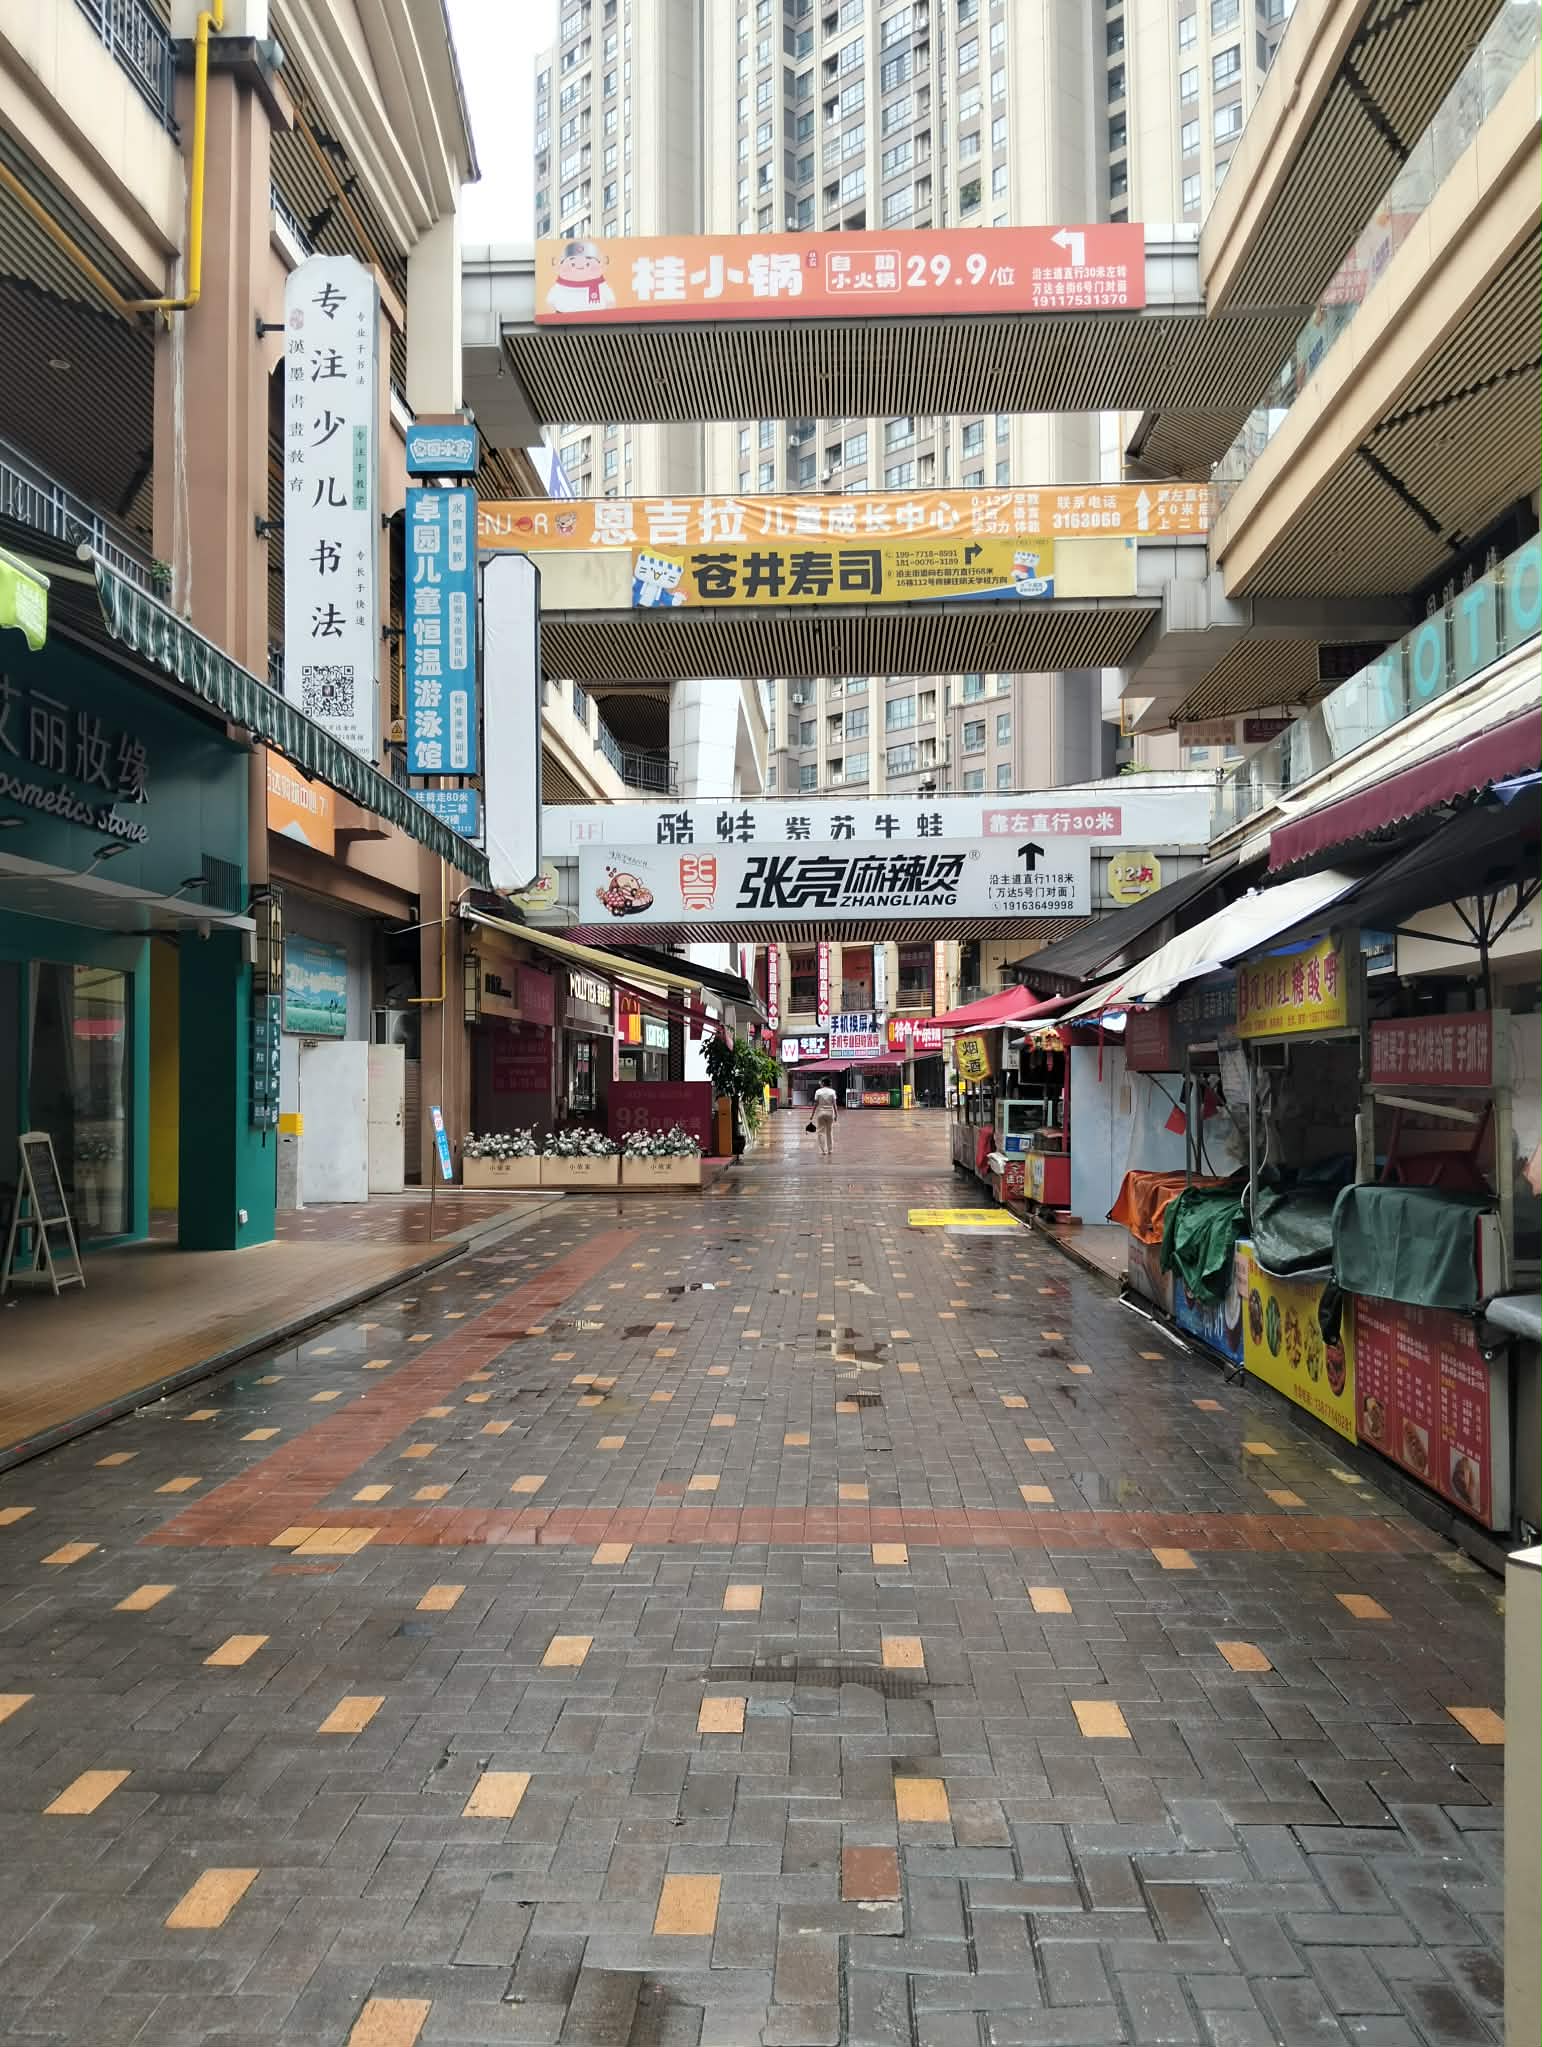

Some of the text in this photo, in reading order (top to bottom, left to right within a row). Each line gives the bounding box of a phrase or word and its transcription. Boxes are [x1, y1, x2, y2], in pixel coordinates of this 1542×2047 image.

[831, 255, 897, 272] 自助
[632, 253, 804, 300] 桂小锅
[831, 272, 897, 289] 小火锅
[1031, 294, 1128, 307] 19117531370
[310, 281, 349, 640] 专注少儿书法
[1056, 494, 1118, 511] 联系电话
[591, 501, 748, 545] 恩吉拉
[691, 550, 882, 600] 苍井寿司
[785, 812, 944, 840] 紫苏牛蛙
[989, 811, 1115, 833] 靠左直行30米
[736, 852, 967, 909] 张亮麻辣烫
[989, 873, 1075, 885] 沿主道直行118米
[839, 893, 958, 907] ZHANGLIANG
[1003, 901, 1074, 910] 19163649998
[962, 1040, 981, 1073] 烟酒
